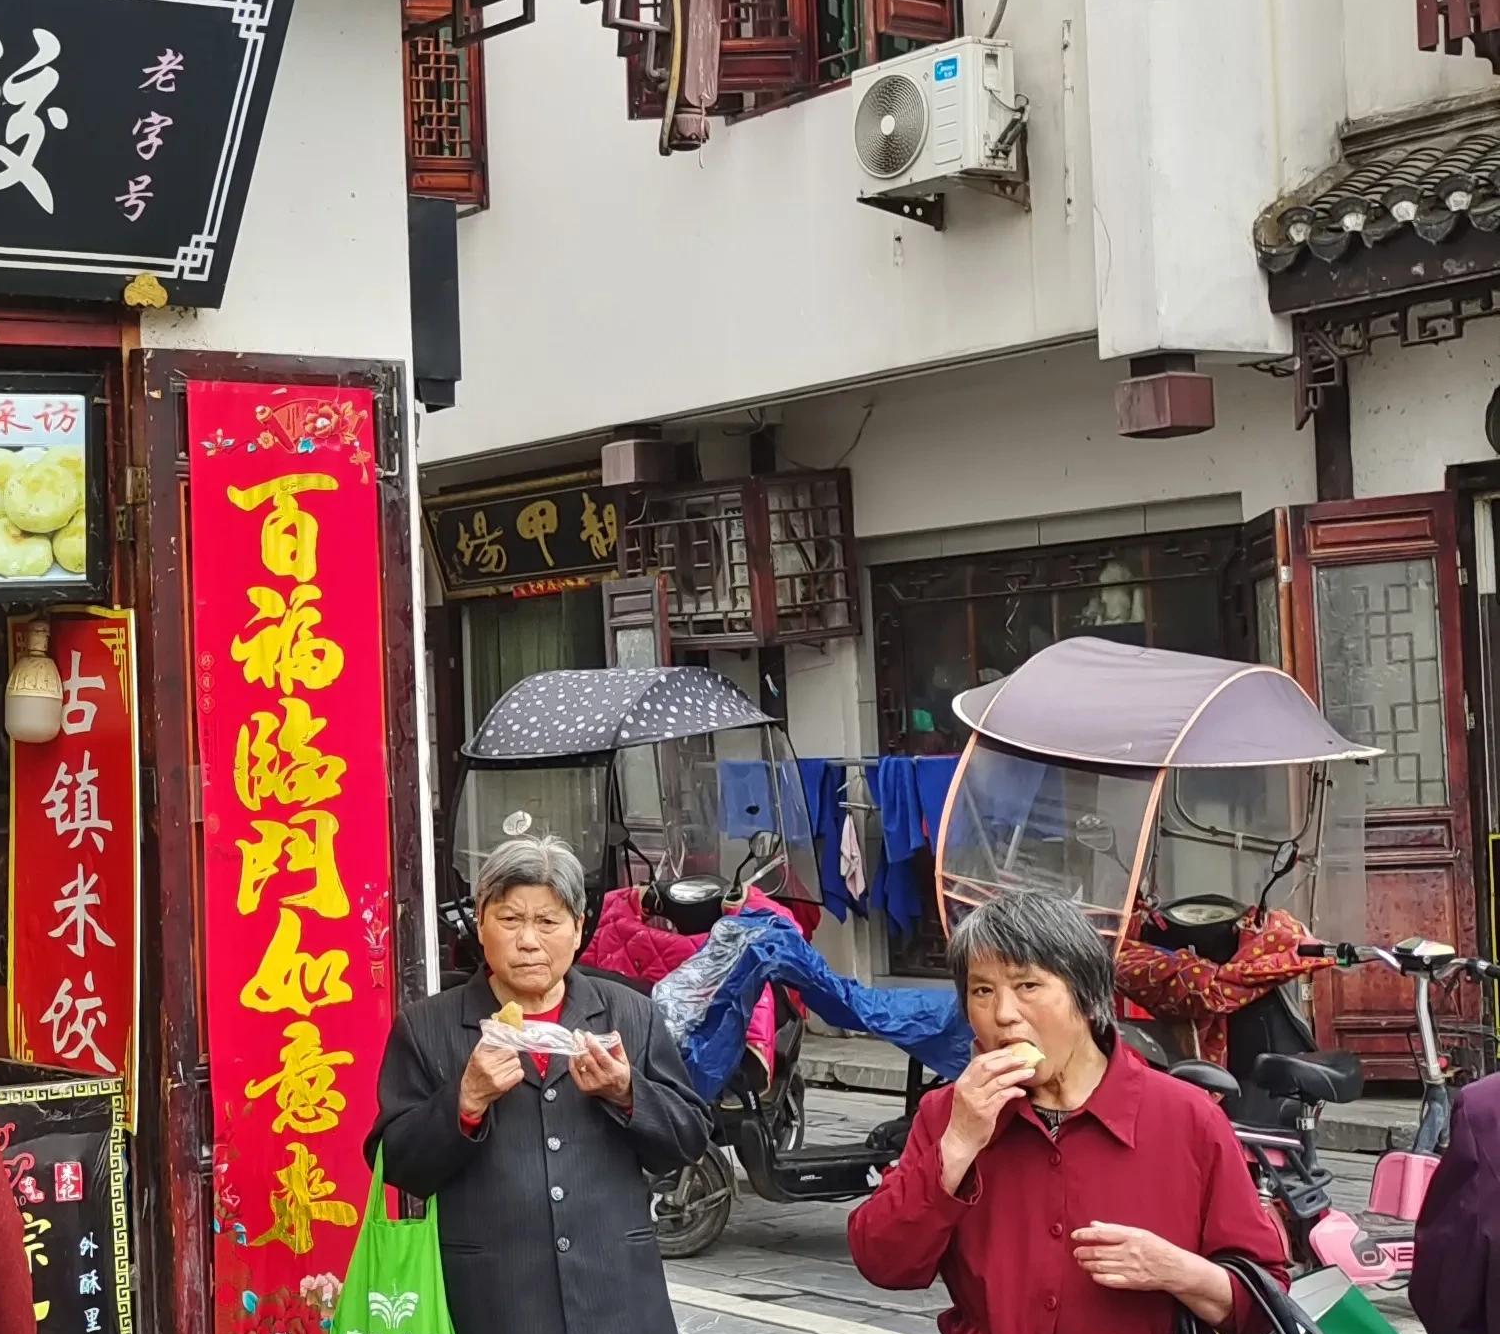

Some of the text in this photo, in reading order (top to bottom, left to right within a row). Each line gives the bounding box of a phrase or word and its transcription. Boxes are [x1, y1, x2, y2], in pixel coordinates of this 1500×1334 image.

[113, 47, 186, 224] 老字号
[39, 651, 117, 1074] 古镇米饺
